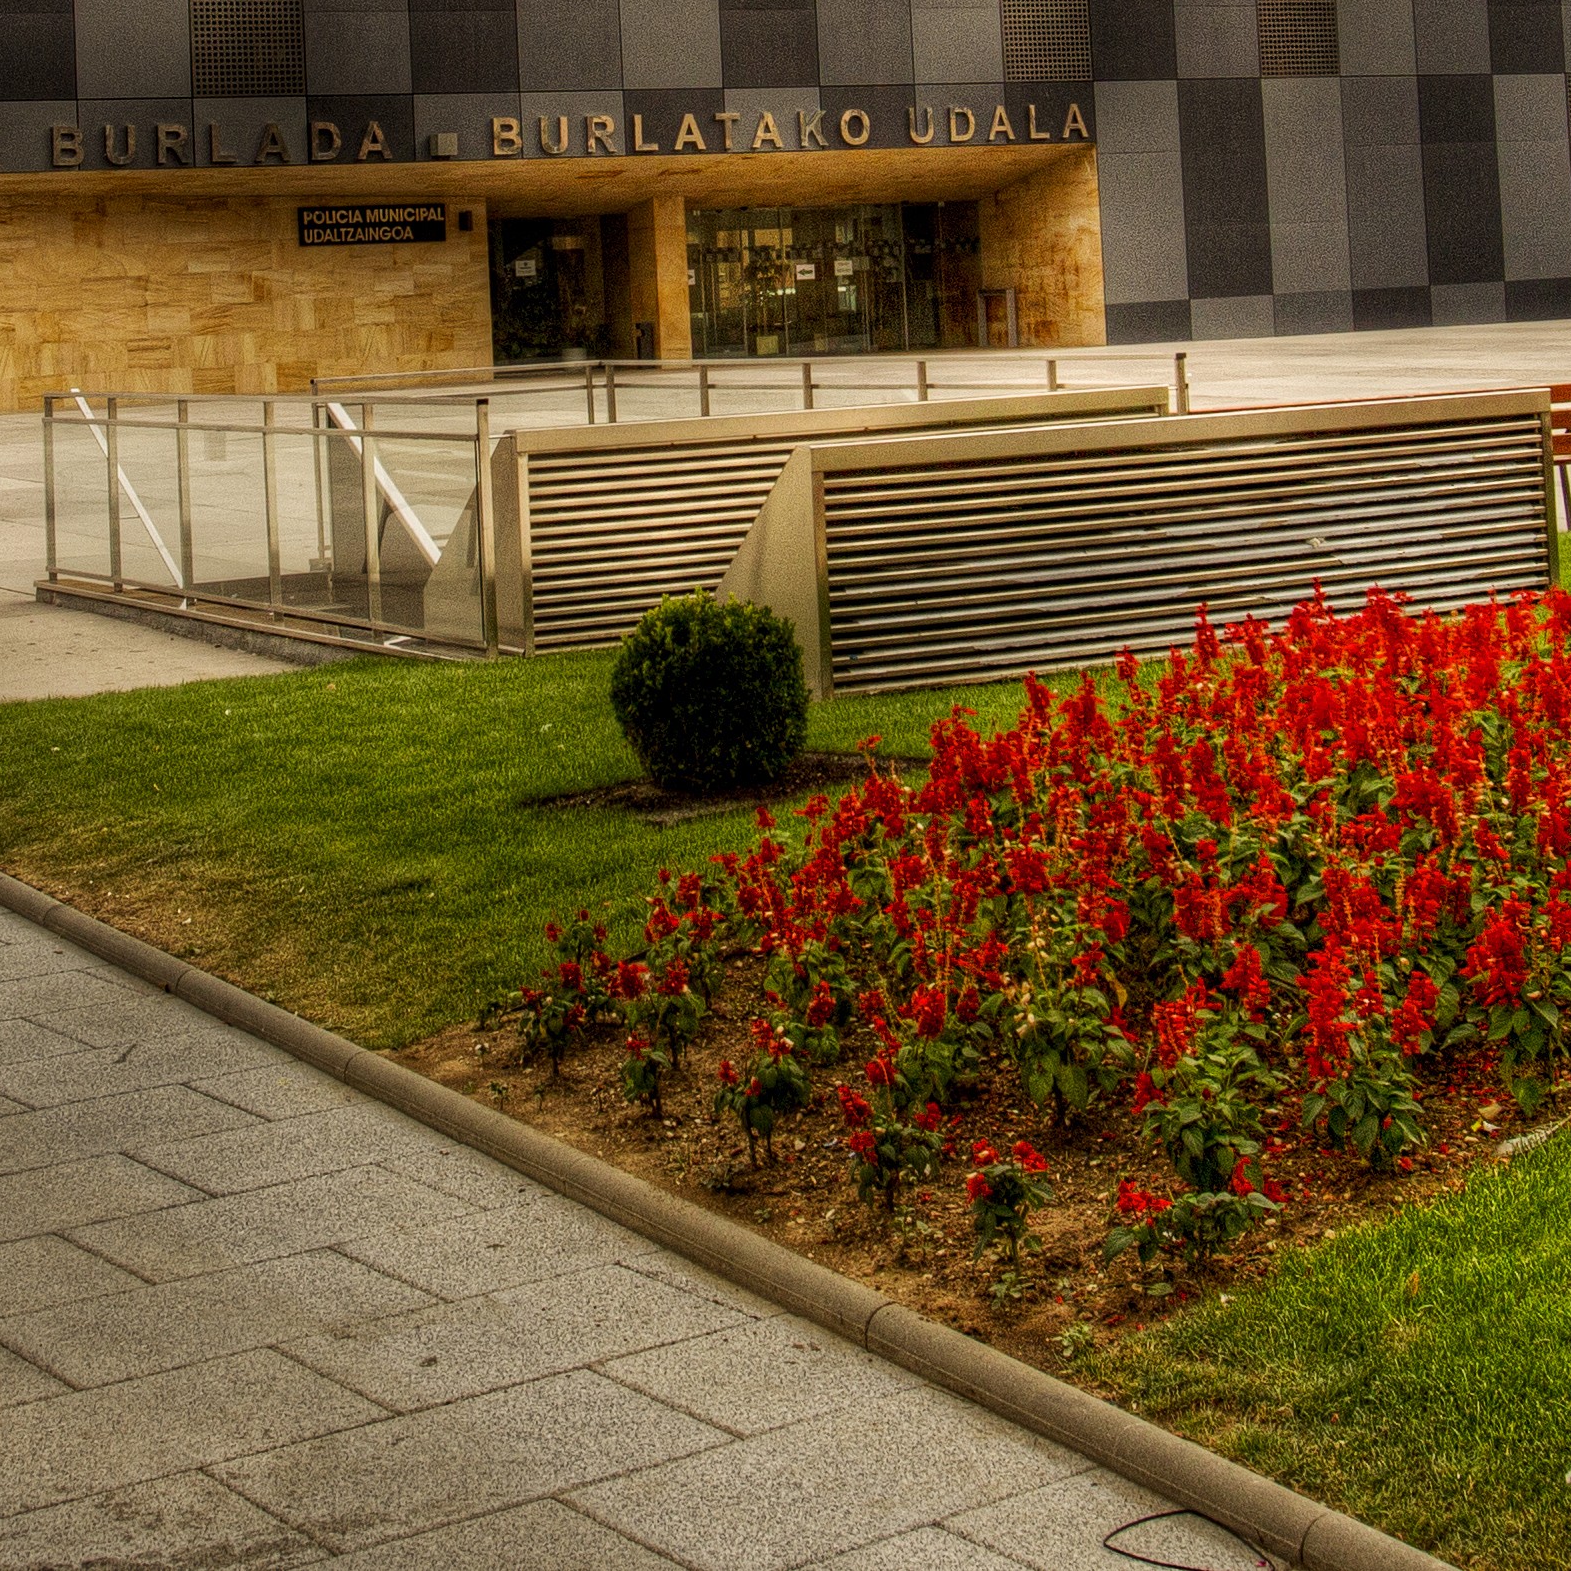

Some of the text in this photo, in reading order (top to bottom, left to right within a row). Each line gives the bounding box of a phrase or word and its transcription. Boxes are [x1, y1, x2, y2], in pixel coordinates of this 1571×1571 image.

[52, 121, 393, 167] BURLADA
[491, 108, 872, 156] BURLATAKO
[908, 103, 1090, 145] UDALA
[303, 207, 445, 225] POLICIA MUNICIPAL
[304, 227, 414, 243] UDALTZAINGOA
